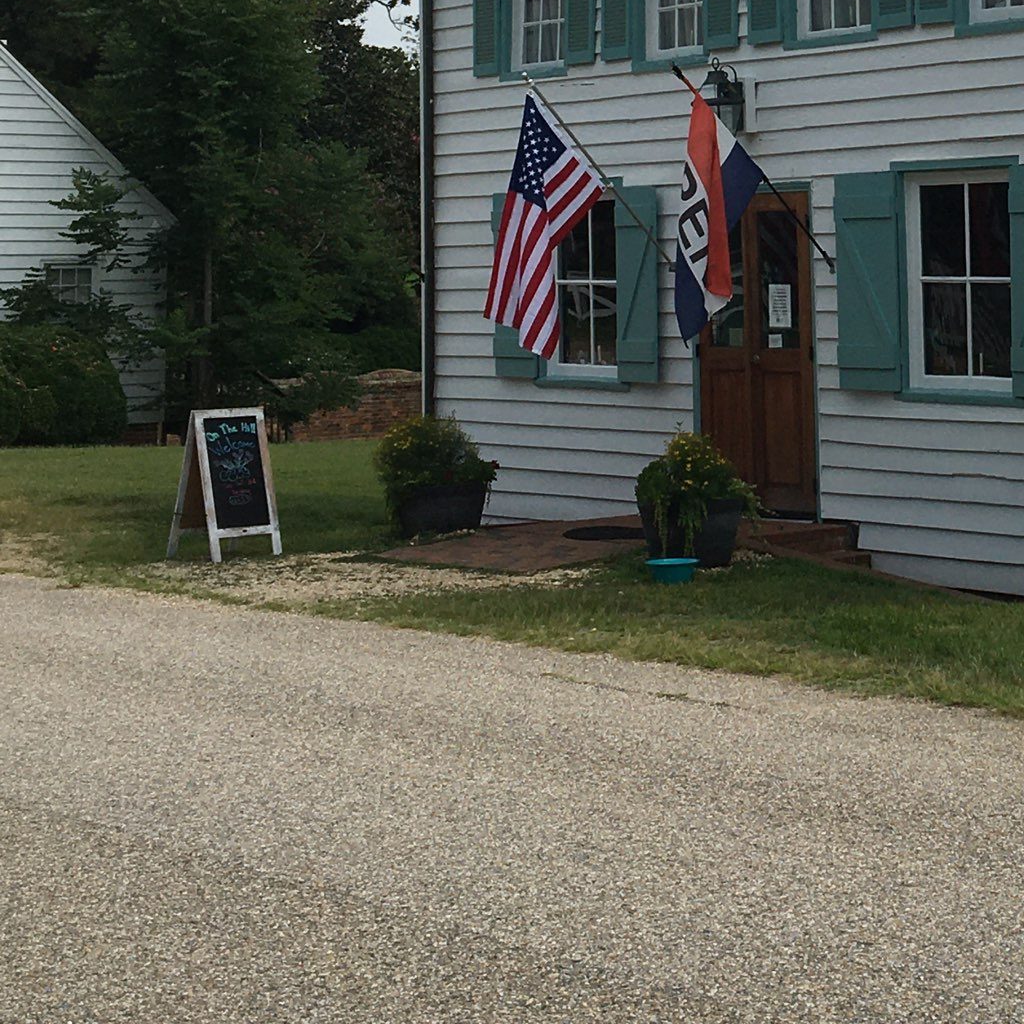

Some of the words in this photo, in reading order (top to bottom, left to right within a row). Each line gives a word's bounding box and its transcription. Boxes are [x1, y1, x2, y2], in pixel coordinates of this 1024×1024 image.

[219, 423, 238, 435] The
[241, 422, 256, 434] Hill
[208, 436, 255, 456] Welcome
